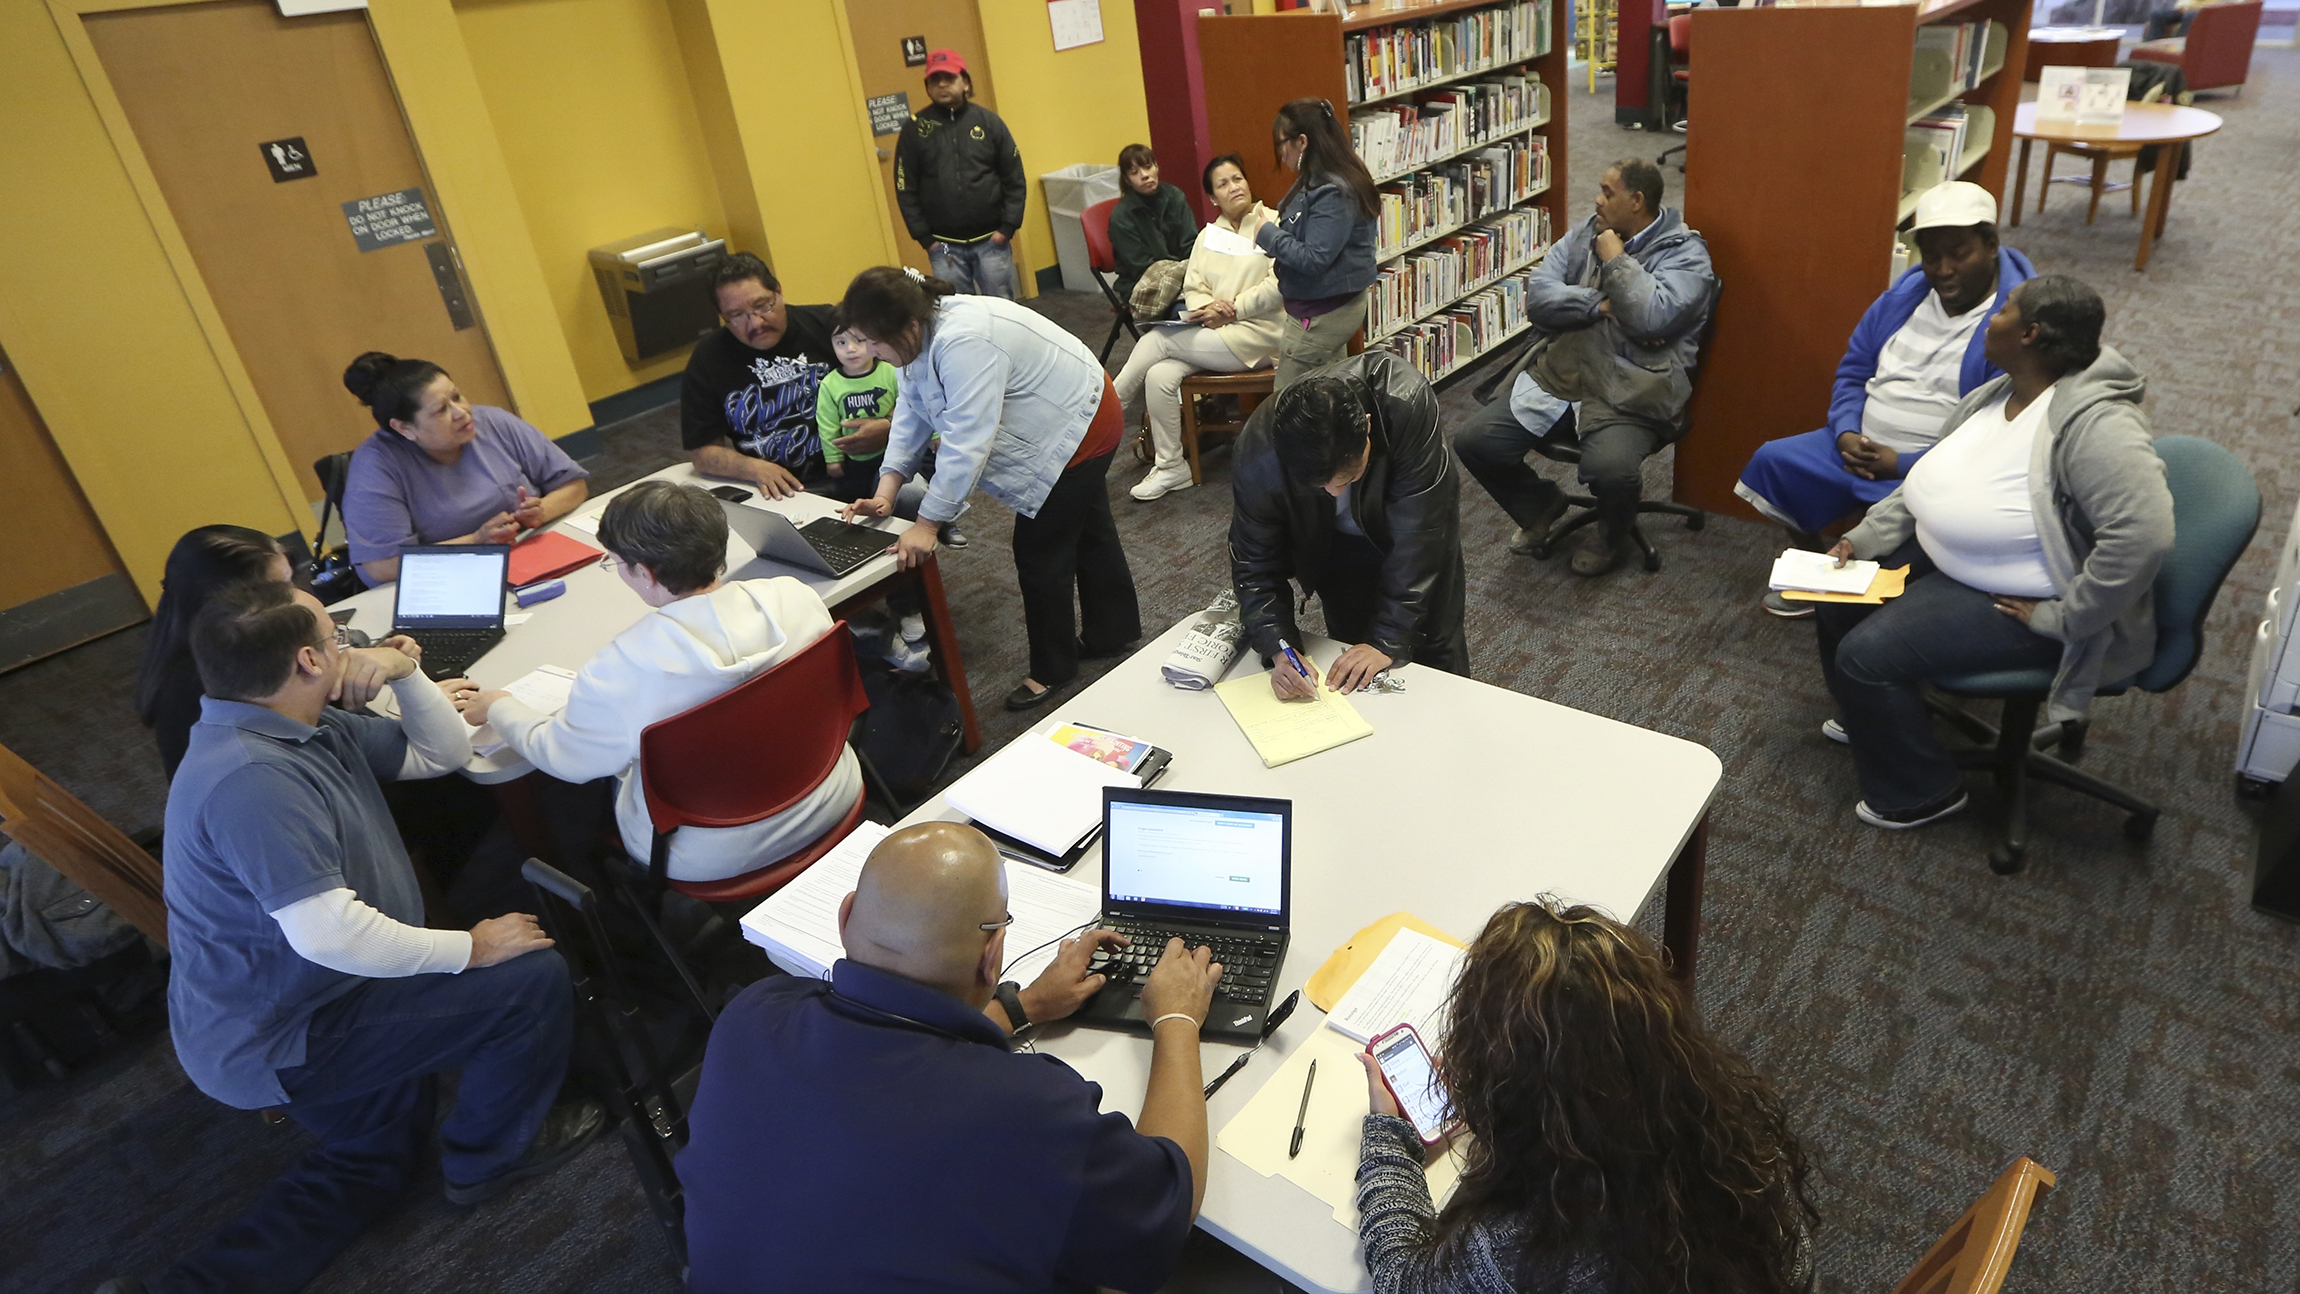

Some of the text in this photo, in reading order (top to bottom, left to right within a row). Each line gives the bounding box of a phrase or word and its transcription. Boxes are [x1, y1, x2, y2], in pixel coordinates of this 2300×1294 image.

[868, 95, 896, 108] PLEASE
[358, 192, 405, 212] PLEASE
[348, 202, 424, 226] DO NOT KNOCK
[352, 210, 430, 236] ON DOOR WHEN
[847, 393, 875, 408] HUNK
[1183, 643, 1219, 659] FIRST
